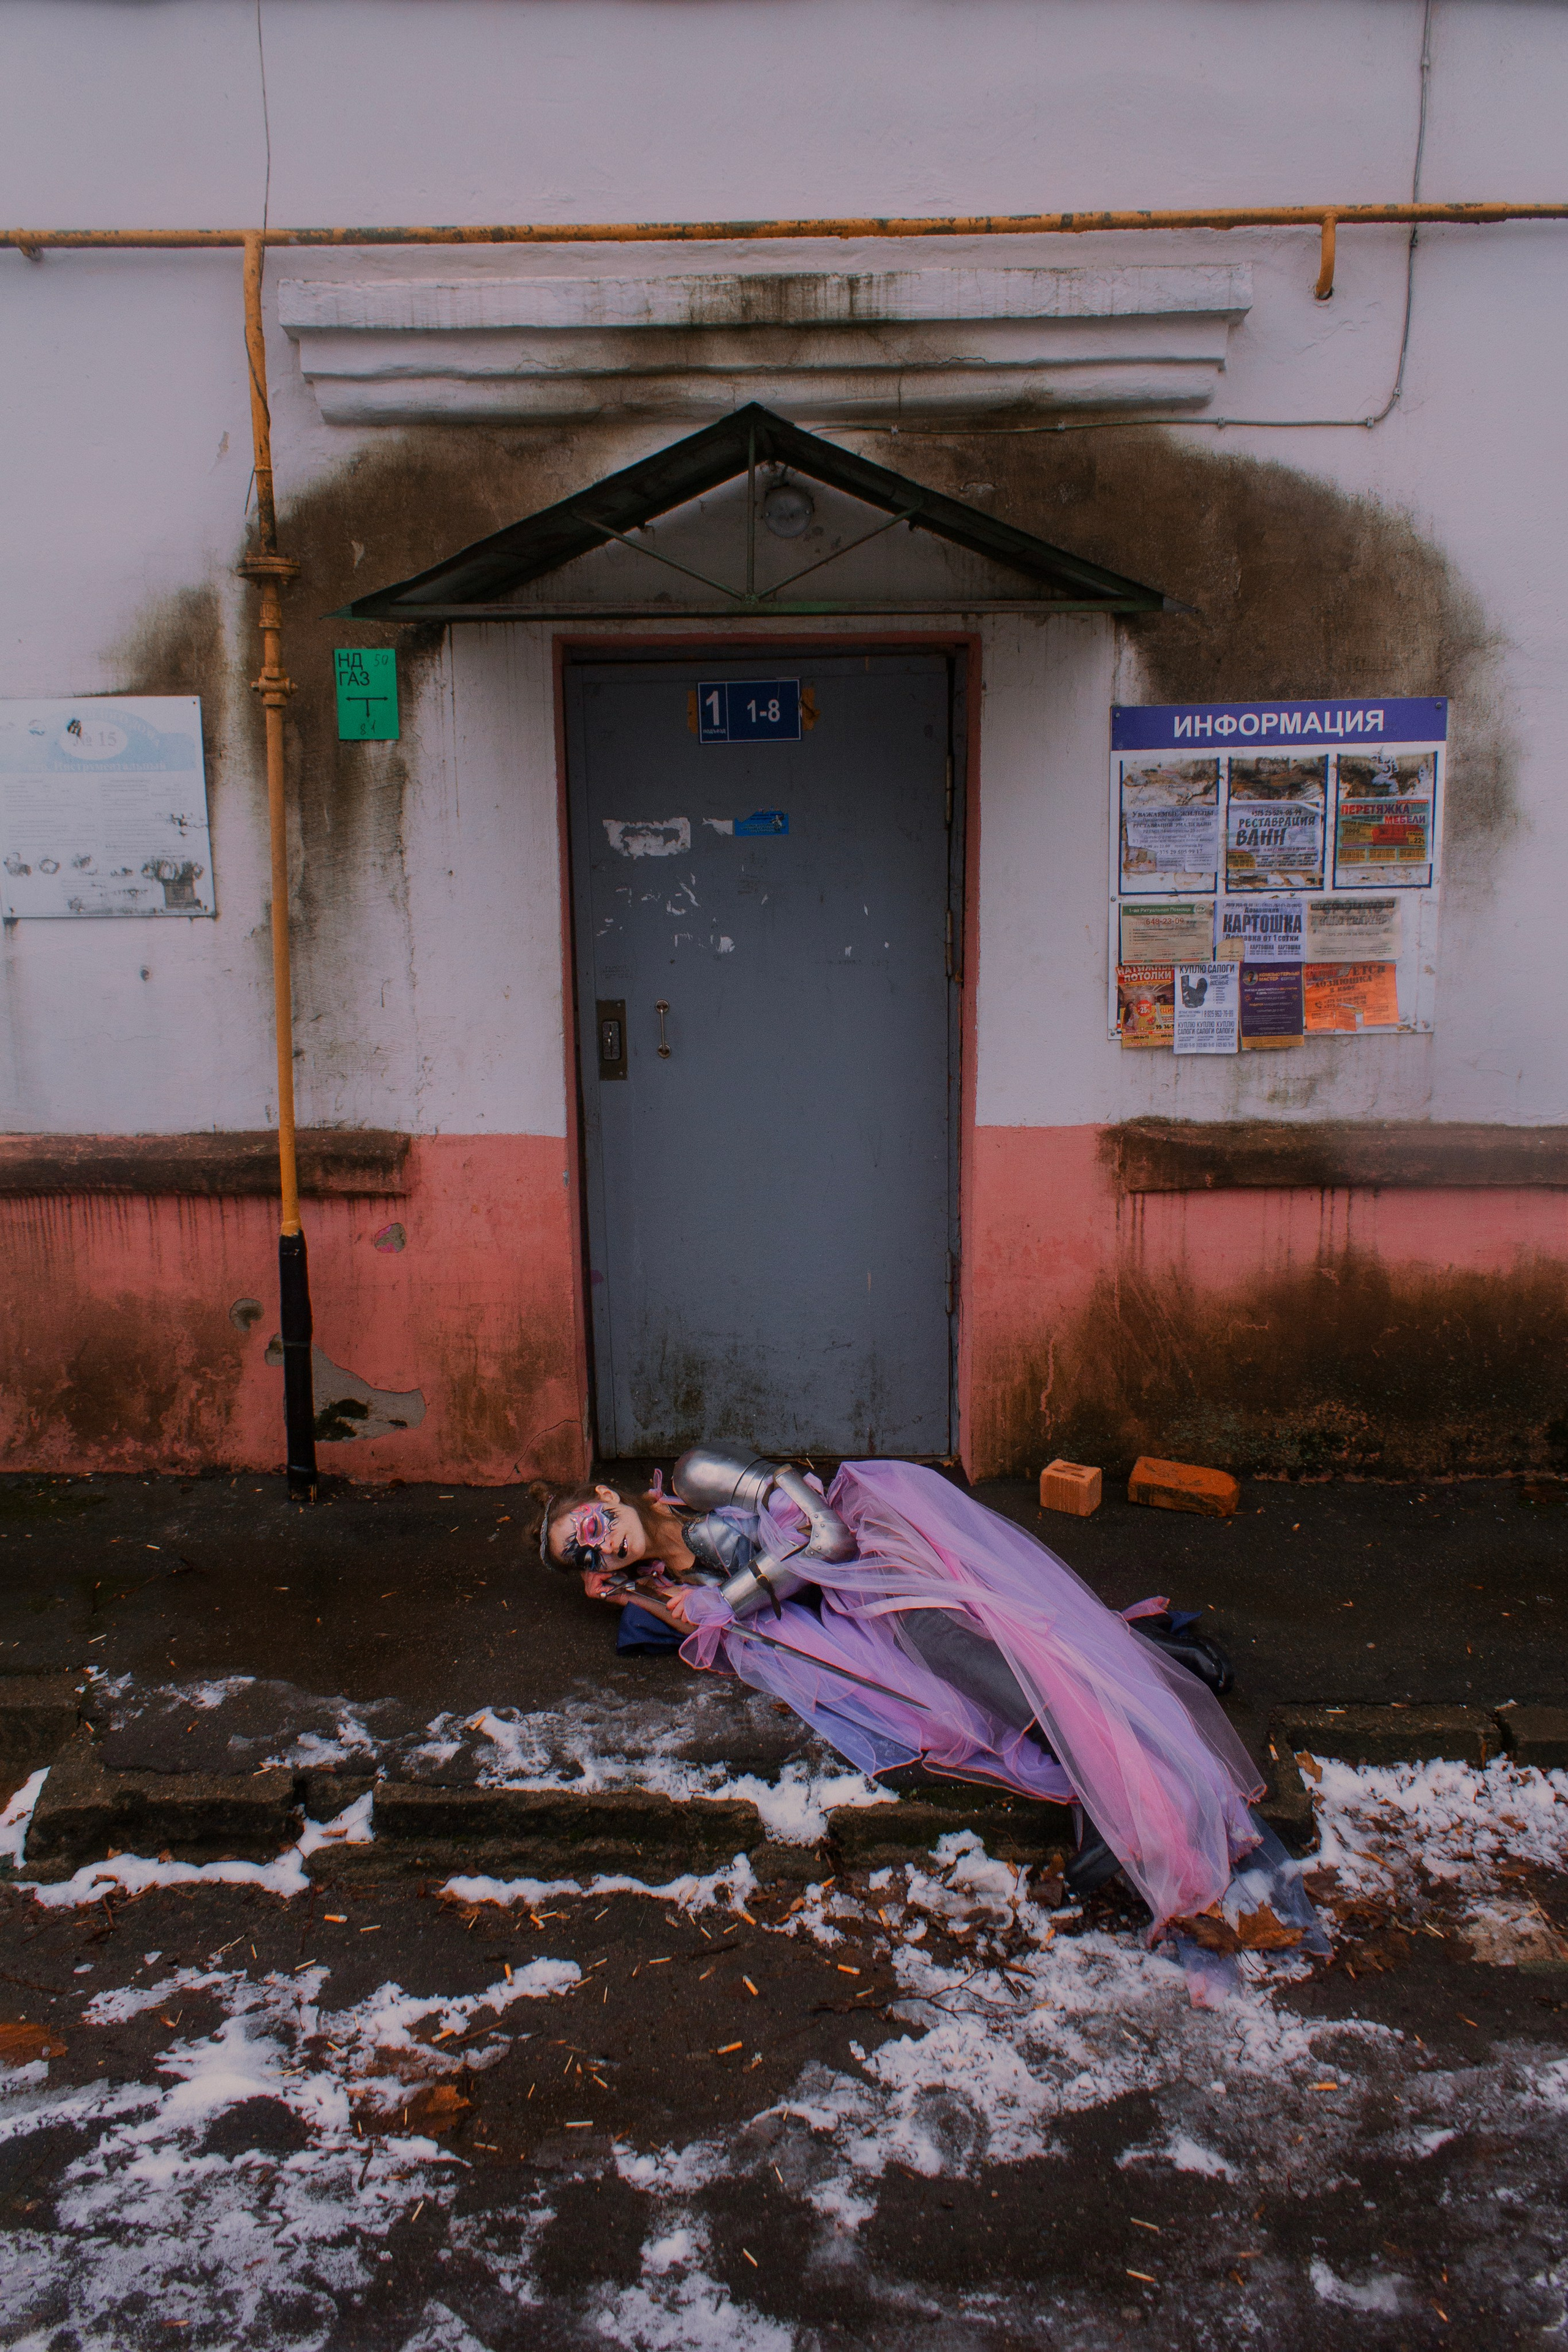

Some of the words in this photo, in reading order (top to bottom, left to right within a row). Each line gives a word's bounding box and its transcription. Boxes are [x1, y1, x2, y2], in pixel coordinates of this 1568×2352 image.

[337, 653, 363, 670] НД
[374, 654, 388, 667] 50
[339, 671, 370, 686] ГАЗ
[706, 690, 720, 726] 1
[747, 699, 780, 723] 1-8
[1174, 709, 1384, 738] ИНФОРМАЦИЯ
[99, 731, 117, 747] 15
[1341, 804, 1411, 815] ПЕРЕТЯЖКА
[1239, 816, 1316, 827] РЕСТАВРАЦИЯ
[1384, 815, 1426, 824] МЕБЕЛИ
[1235, 827, 1287, 846] ВАНН
[1223, 914, 1302, 933] КАРТОШКА
[1124, 971, 1172, 982] ПОТОЛКИ
[1179, 964, 1206, 974] КУПЛЮ
[1207, 964, 1235, 973] САПОГИ
